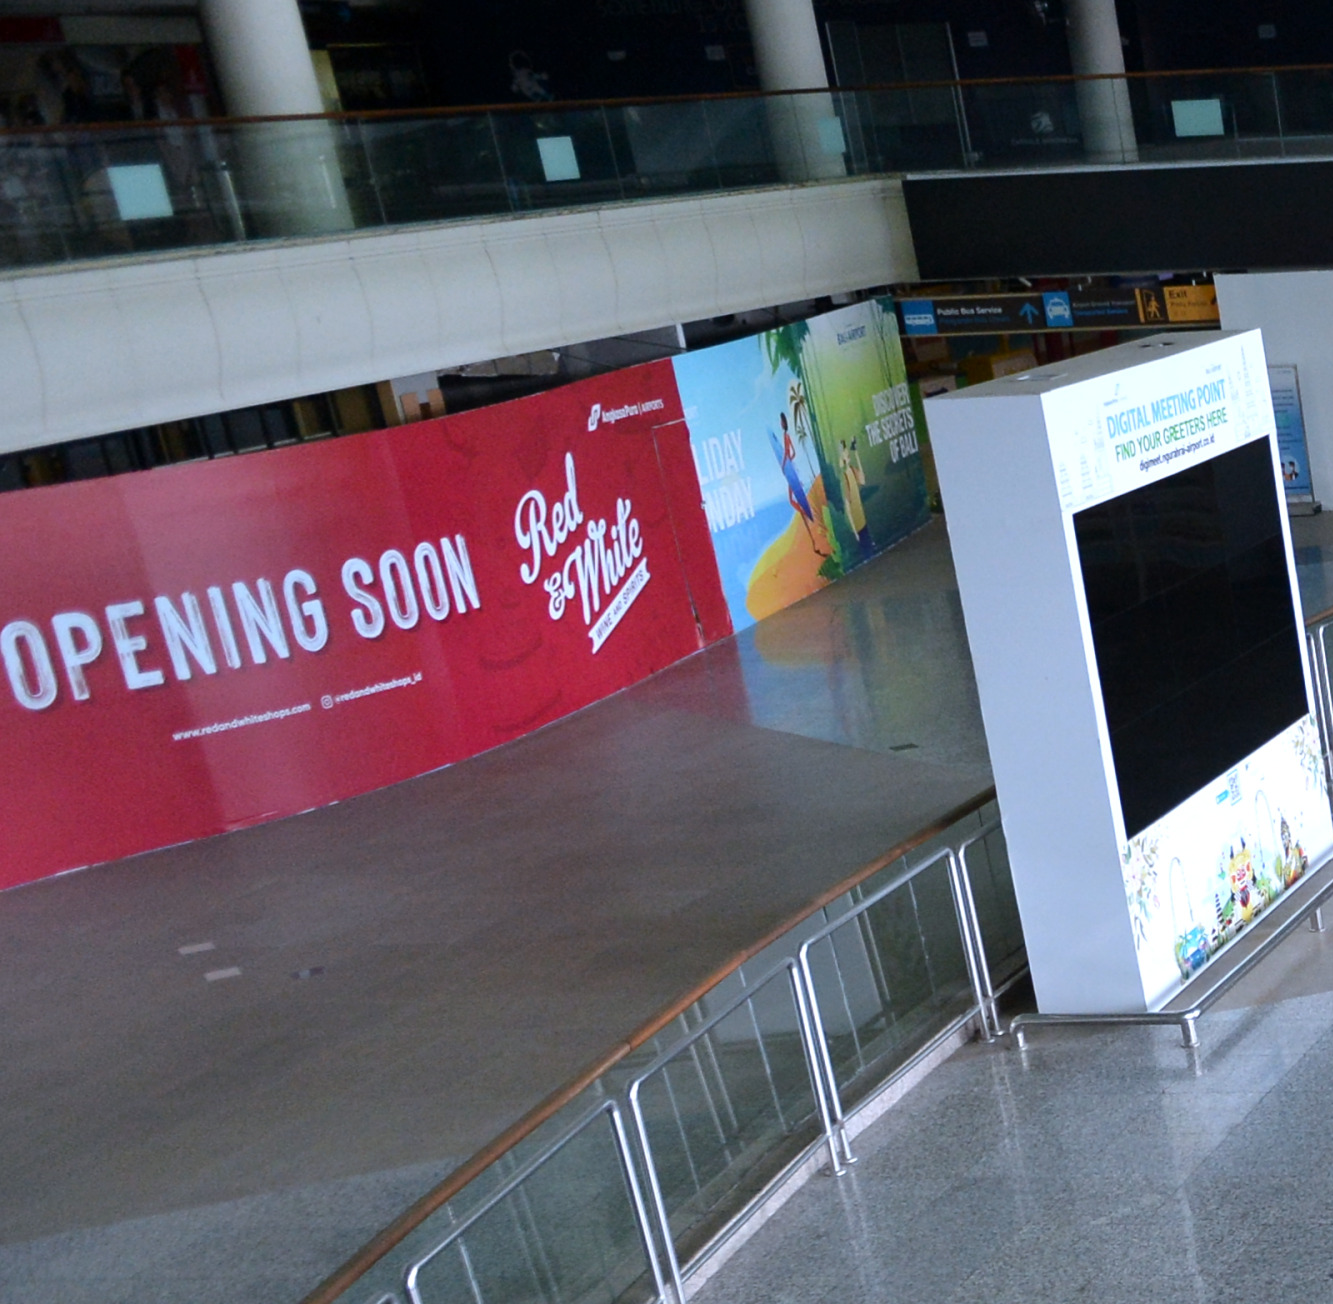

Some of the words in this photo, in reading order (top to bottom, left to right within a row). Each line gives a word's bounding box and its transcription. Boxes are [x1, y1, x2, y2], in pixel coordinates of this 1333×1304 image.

[1106, 405, 1151, 439] DIGITAL
[1151, 389, 1197, 423] MEETING
[1196, 379, 1226, 408] POINT
[1115, 442, 1137, 463] FIND
[1138, 430, 1161, 454] YOUR
[1163, 414, 1206, 446] GREETERS
[1207, 407, 1228, 430] HERE
[515, 452, 583, 584] Red
[563, 498, 643, 626] White
[0, 568, 329, 711] OPENING
[341, 533, 481, 639] SOON
[172, 702, 312, 742] www.redandwhiteshops.com
